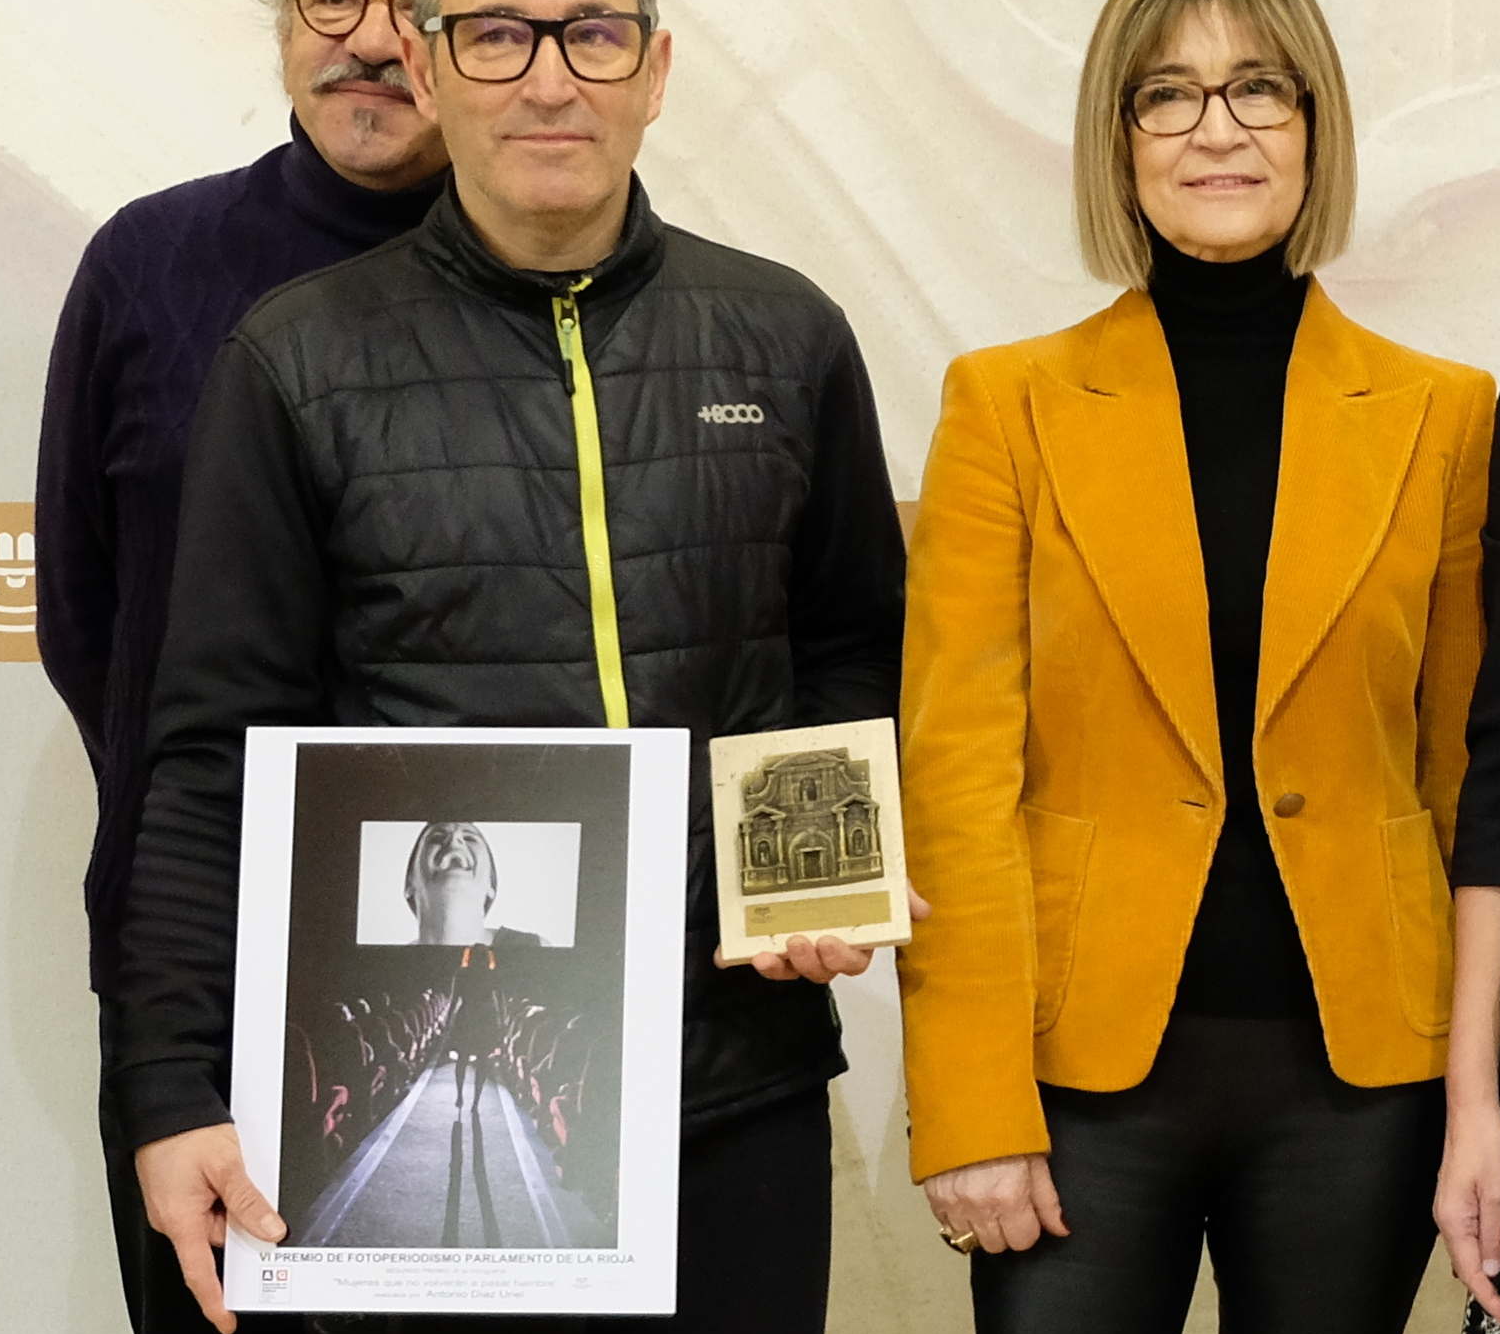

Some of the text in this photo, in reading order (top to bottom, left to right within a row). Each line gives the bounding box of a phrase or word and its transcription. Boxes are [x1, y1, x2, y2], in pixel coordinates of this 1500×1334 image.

[259, 1252, 636, 1265] VI PREMIO DE FOTOPERIODISMO PARLAMENTO DE LA RIOJA
